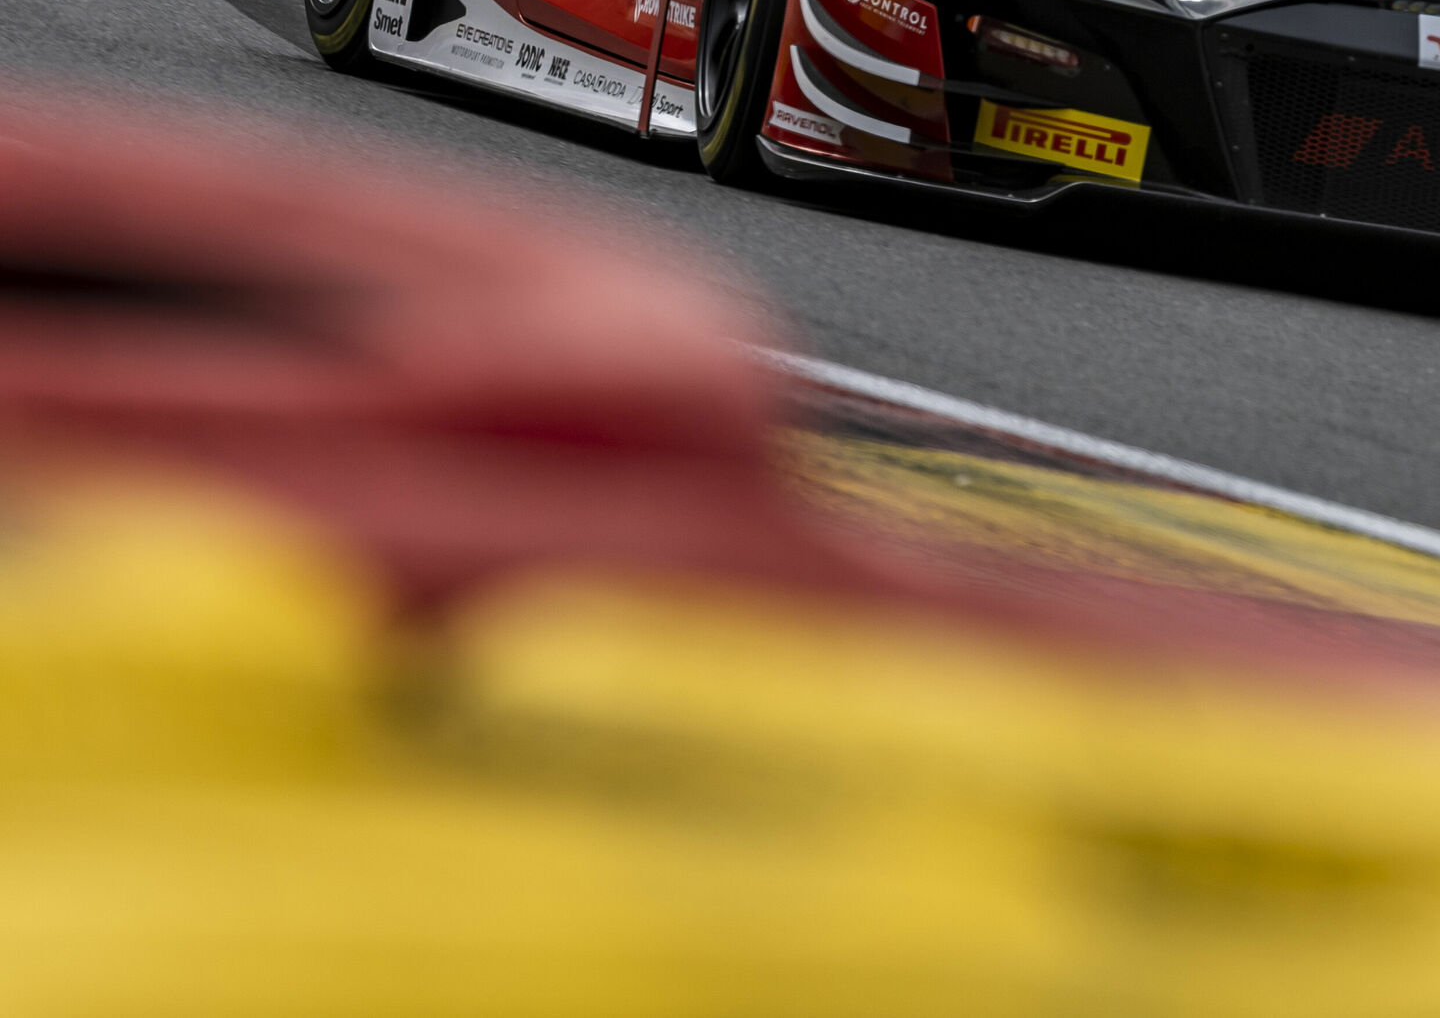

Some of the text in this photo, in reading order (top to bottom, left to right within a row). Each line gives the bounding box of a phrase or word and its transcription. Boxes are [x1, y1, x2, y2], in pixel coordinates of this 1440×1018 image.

[374, 7, 404, 38] Smet
[456, 23, 474, 42] EYE
[515, 42, 545, 73] SONIC
[990, 104, 1132, 167] PIRELLI
